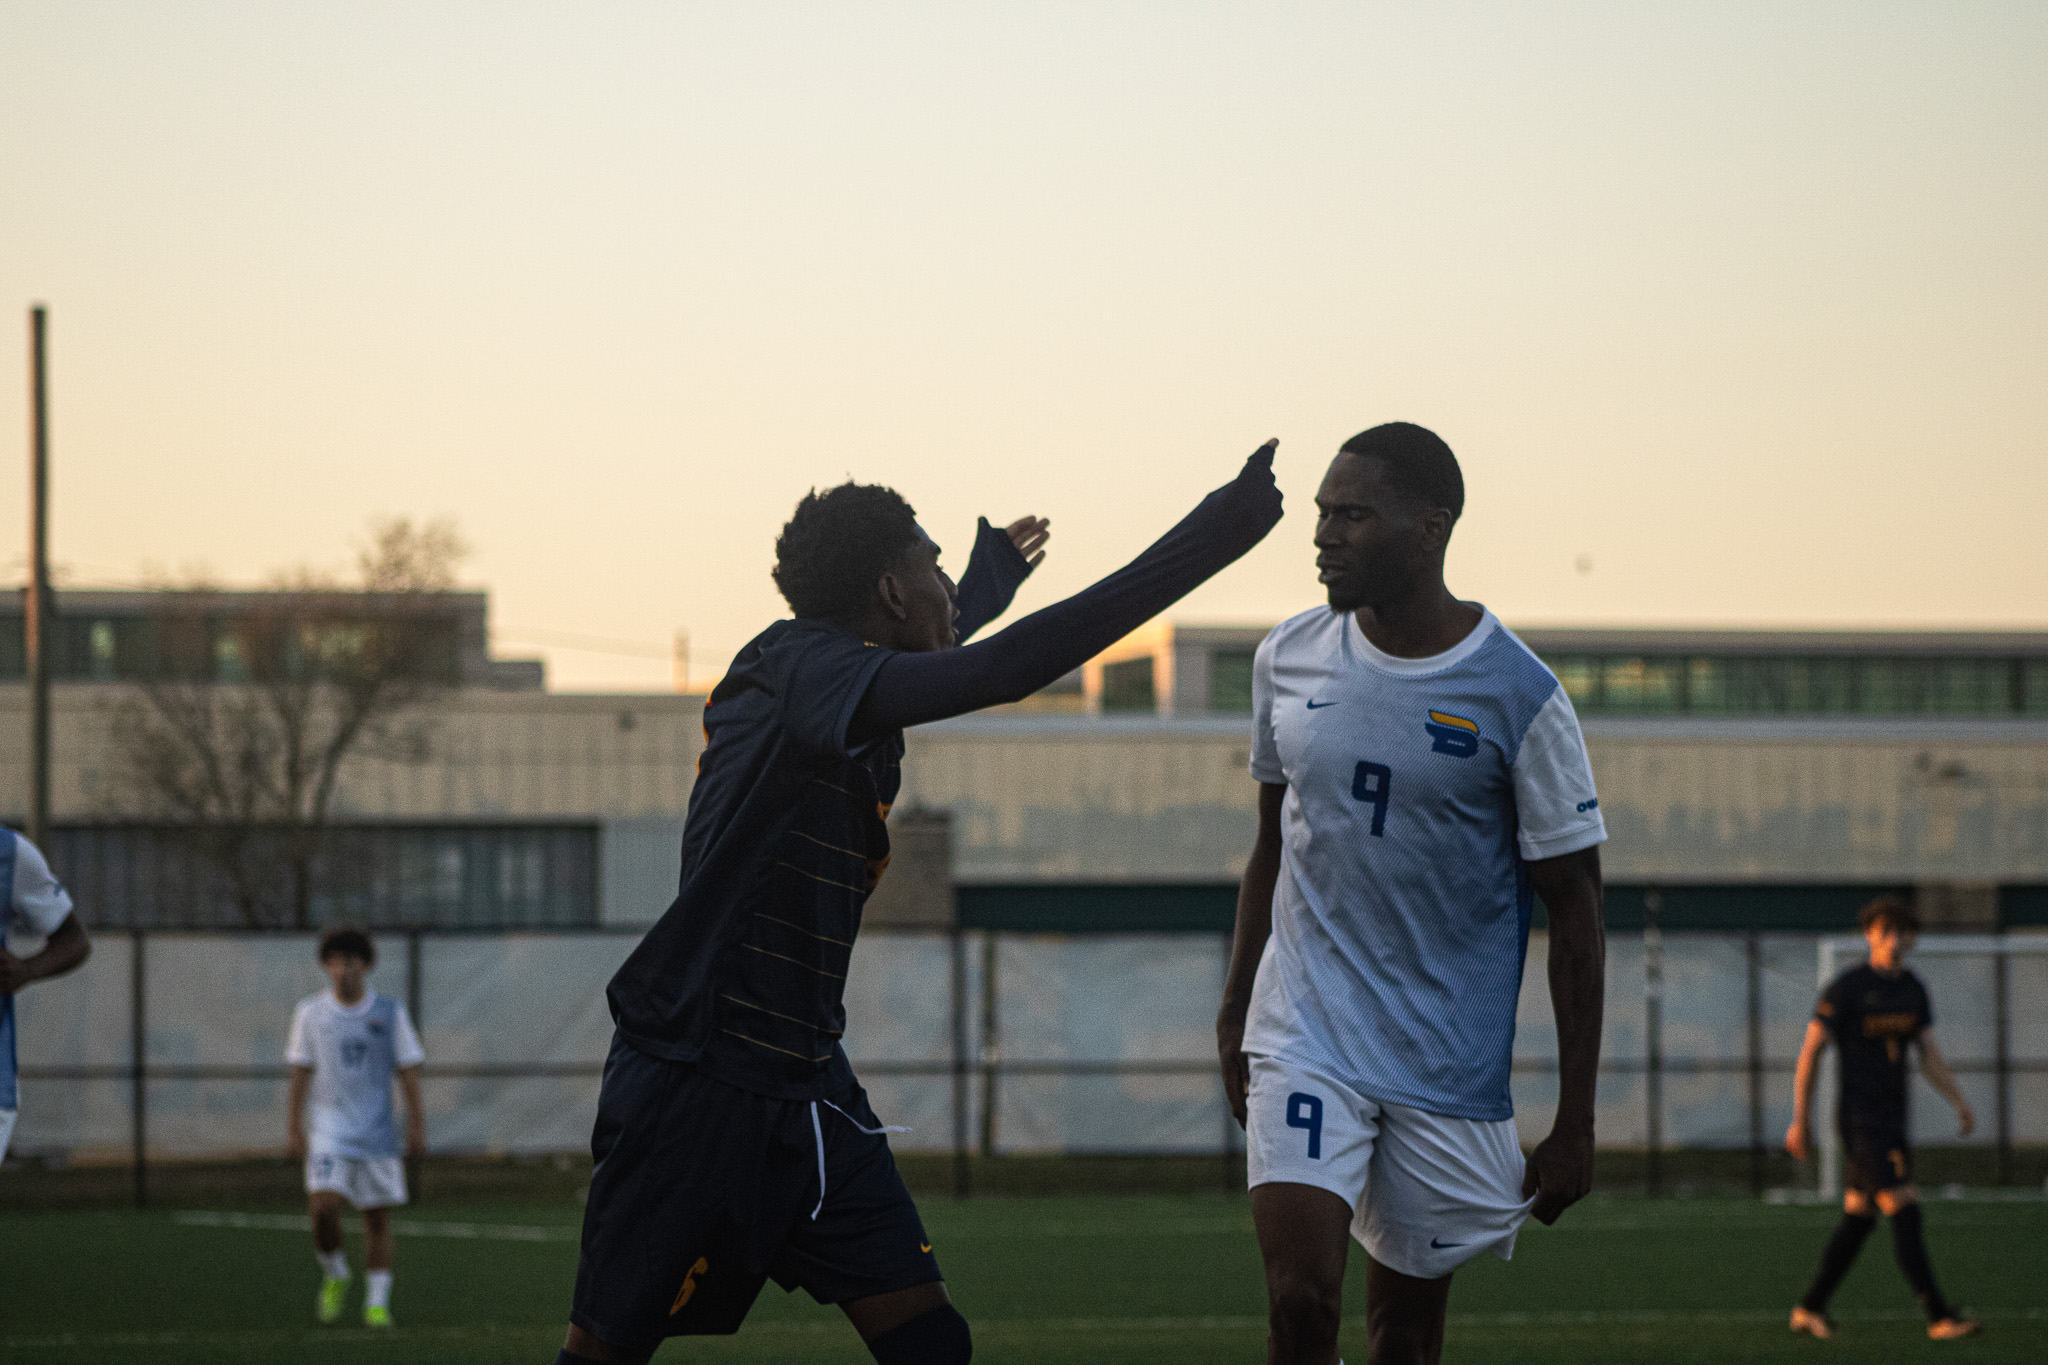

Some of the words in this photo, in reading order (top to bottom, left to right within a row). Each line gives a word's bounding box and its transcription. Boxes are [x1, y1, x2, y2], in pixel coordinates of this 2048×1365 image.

[1352, 760, 1391, 838] 9
[1286, 1091, 1323, 1160] 9
[669, 1256, 709, 1317] 6
